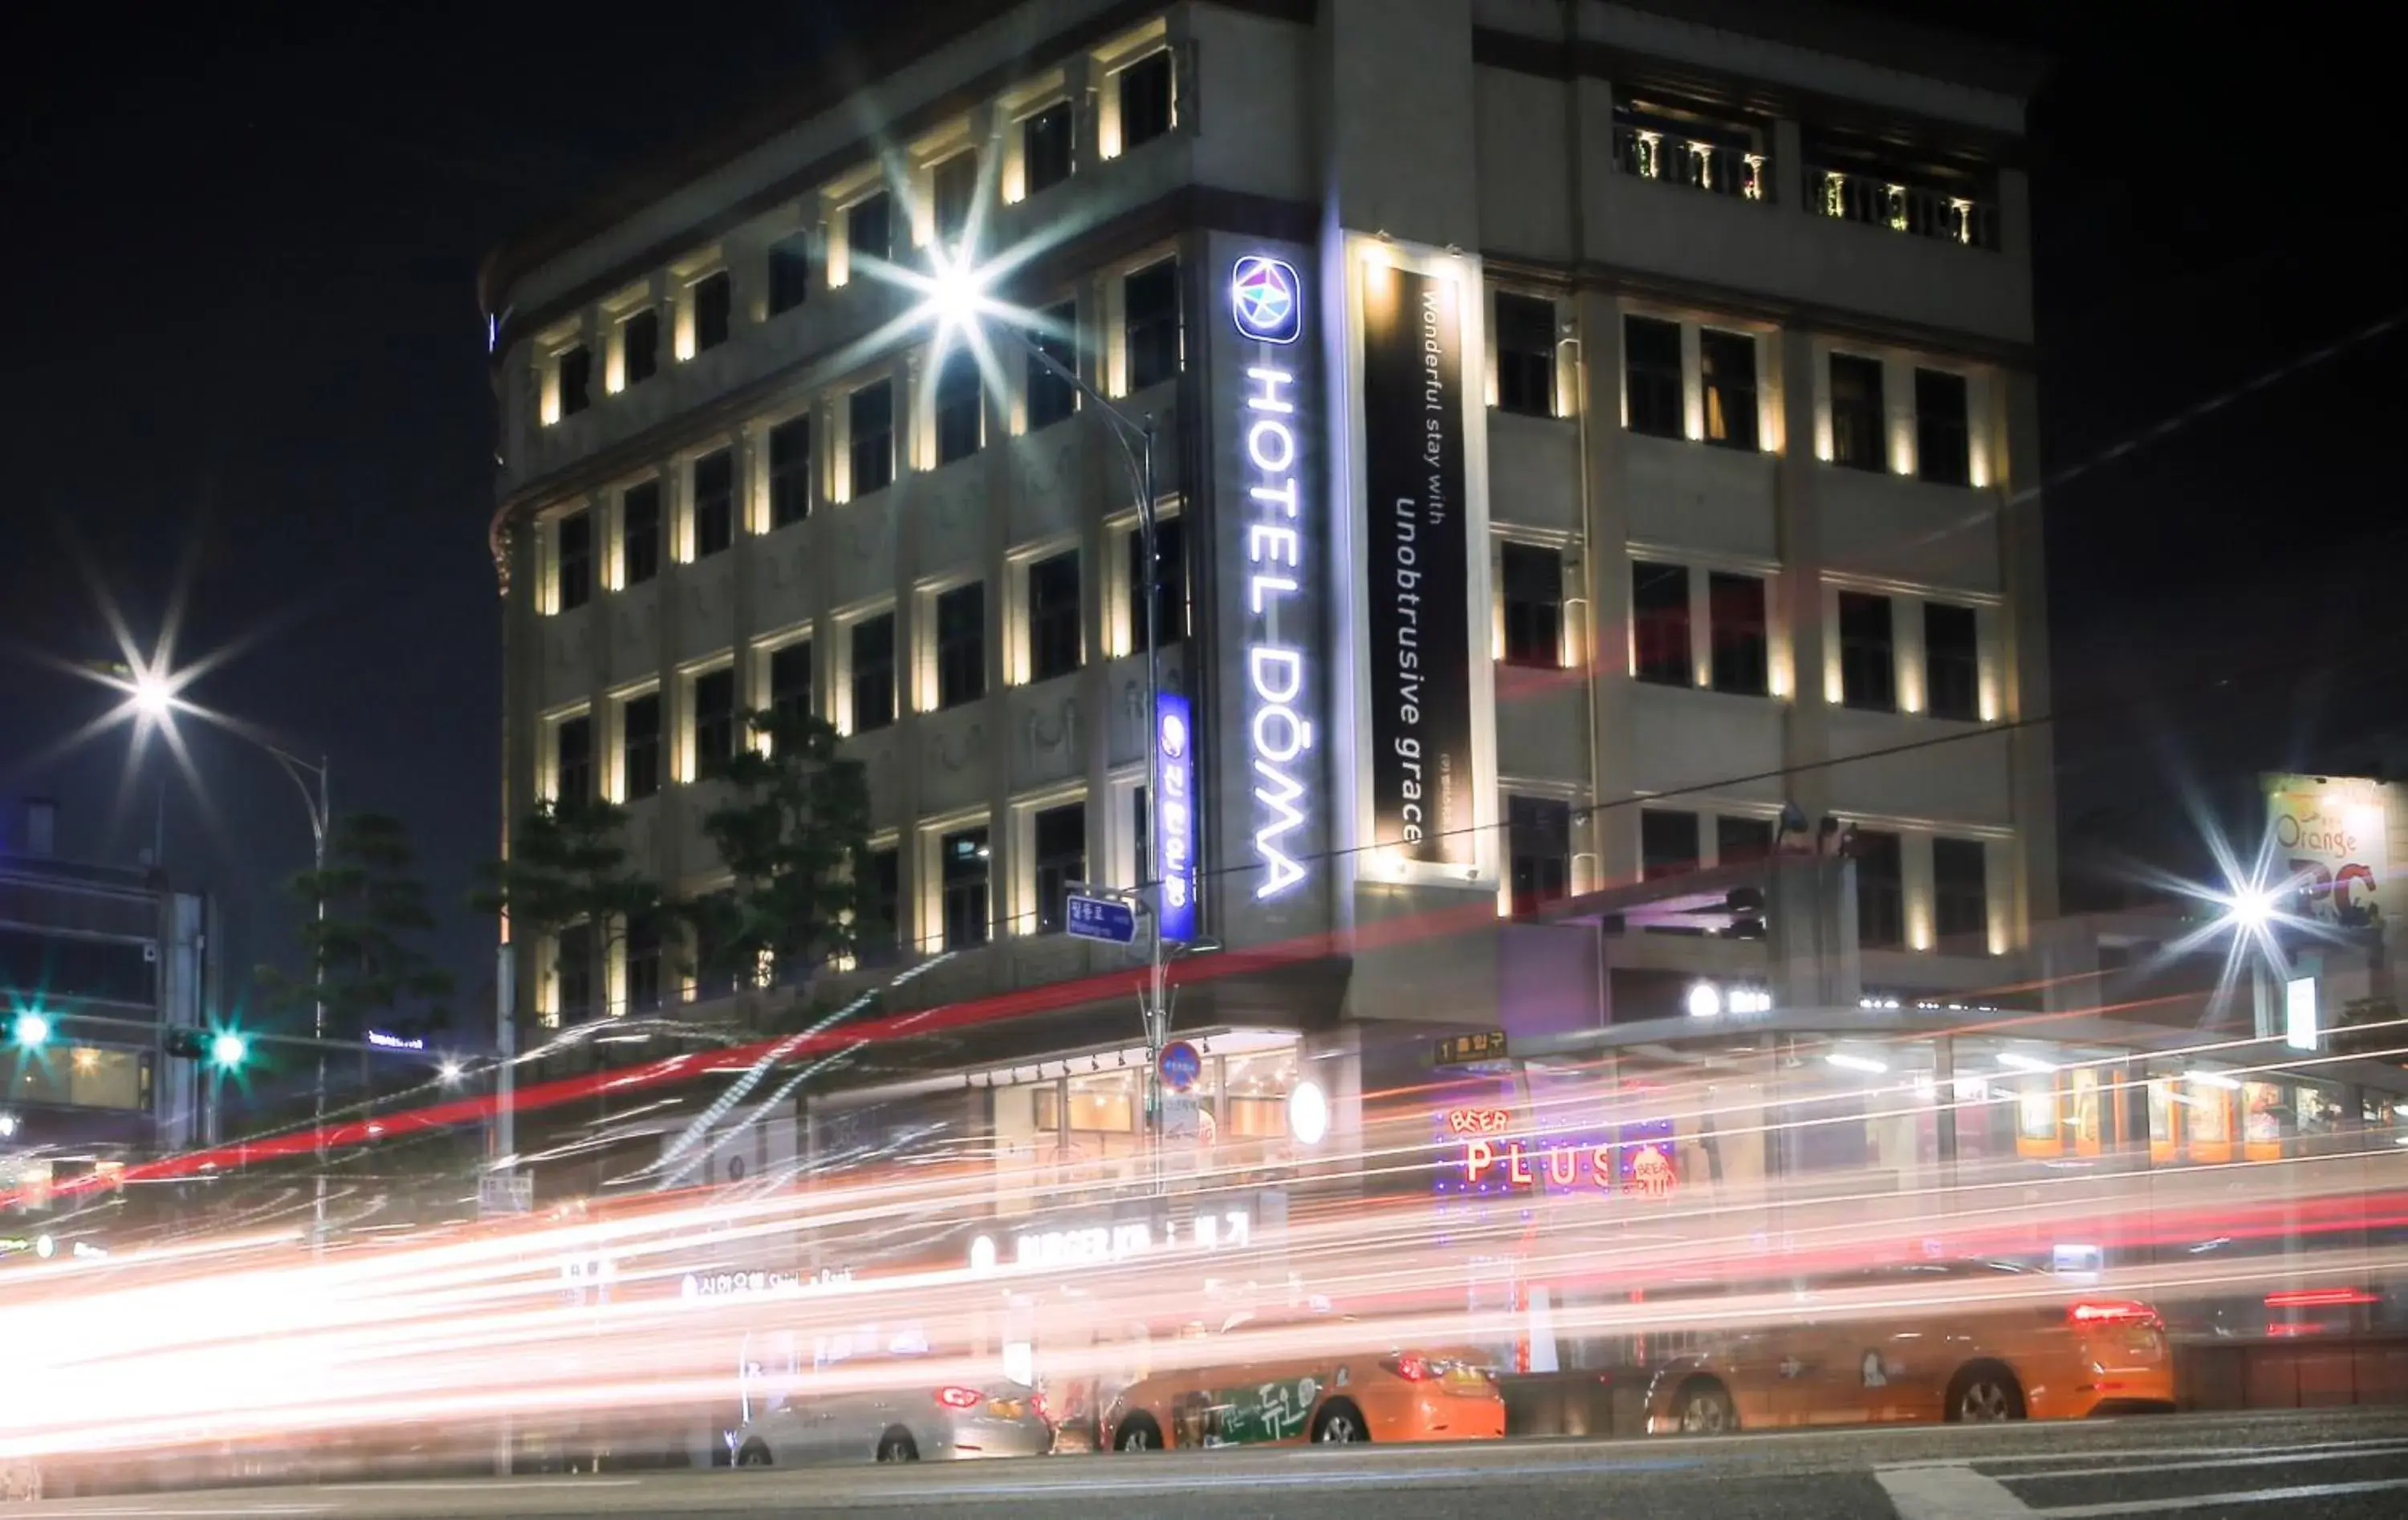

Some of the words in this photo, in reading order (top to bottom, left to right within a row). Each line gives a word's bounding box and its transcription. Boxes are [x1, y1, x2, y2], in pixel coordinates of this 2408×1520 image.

[1423, 418, 1443, 467] stay
[1247, 366, 1298, 615] HOTEL
[1428, 474, 1446, 525] with
[1396, 498, 1426, 725] unobtrusive
[1394, 737, 1423, 847] grace
[2277, 813, 2357, 859] Orange
[1450, 1110, 1509, 1133] BEER
[1466, 1140, 1609, 1186] PLUS
